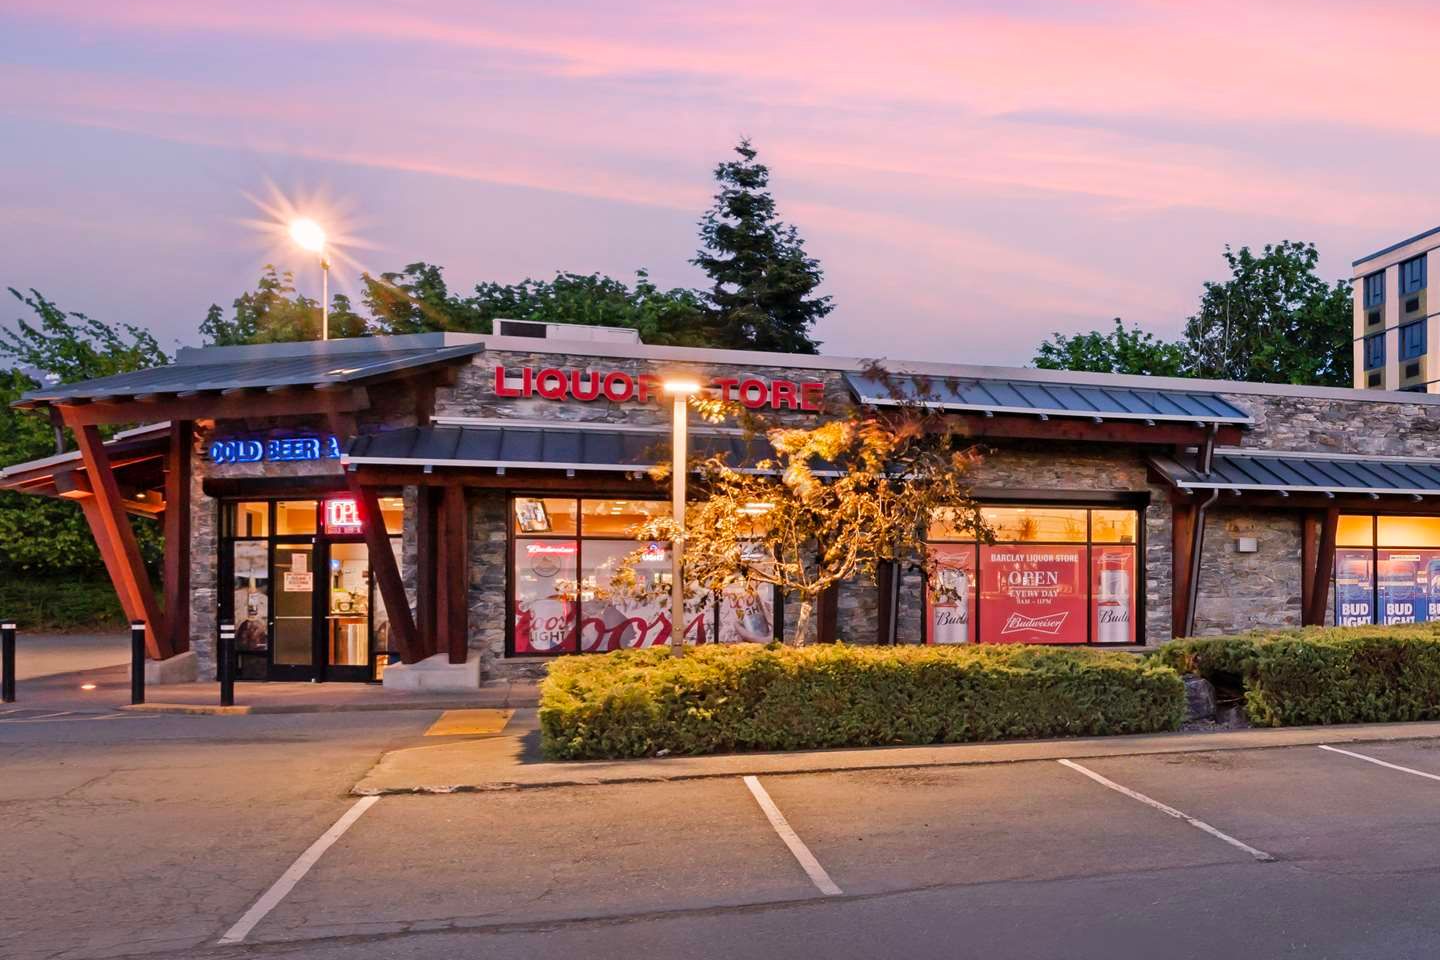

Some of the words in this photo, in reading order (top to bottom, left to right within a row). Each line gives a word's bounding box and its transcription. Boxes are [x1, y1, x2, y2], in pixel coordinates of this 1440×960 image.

[495, 366, 664, 403] LIQUOR
[711, 378, 825, 411] TORE
[210, 440, 264, 464] COLD
[267, 437, 321, 461] BEER
[991, 554, 1024, 562] BARCLAY
[1026, 554, 1053, 563] LIQUOR
[1055, 554, 1079, 562] STORE
[1008, 571, 1059, 585] OPEN
[1009, 590, 1038, 598] EVERY
[1342, 603, 1369, 615] BUD
[1387, 603, 1413, 615] BUD
[1010, 616, 1061, 629] Budweiser
